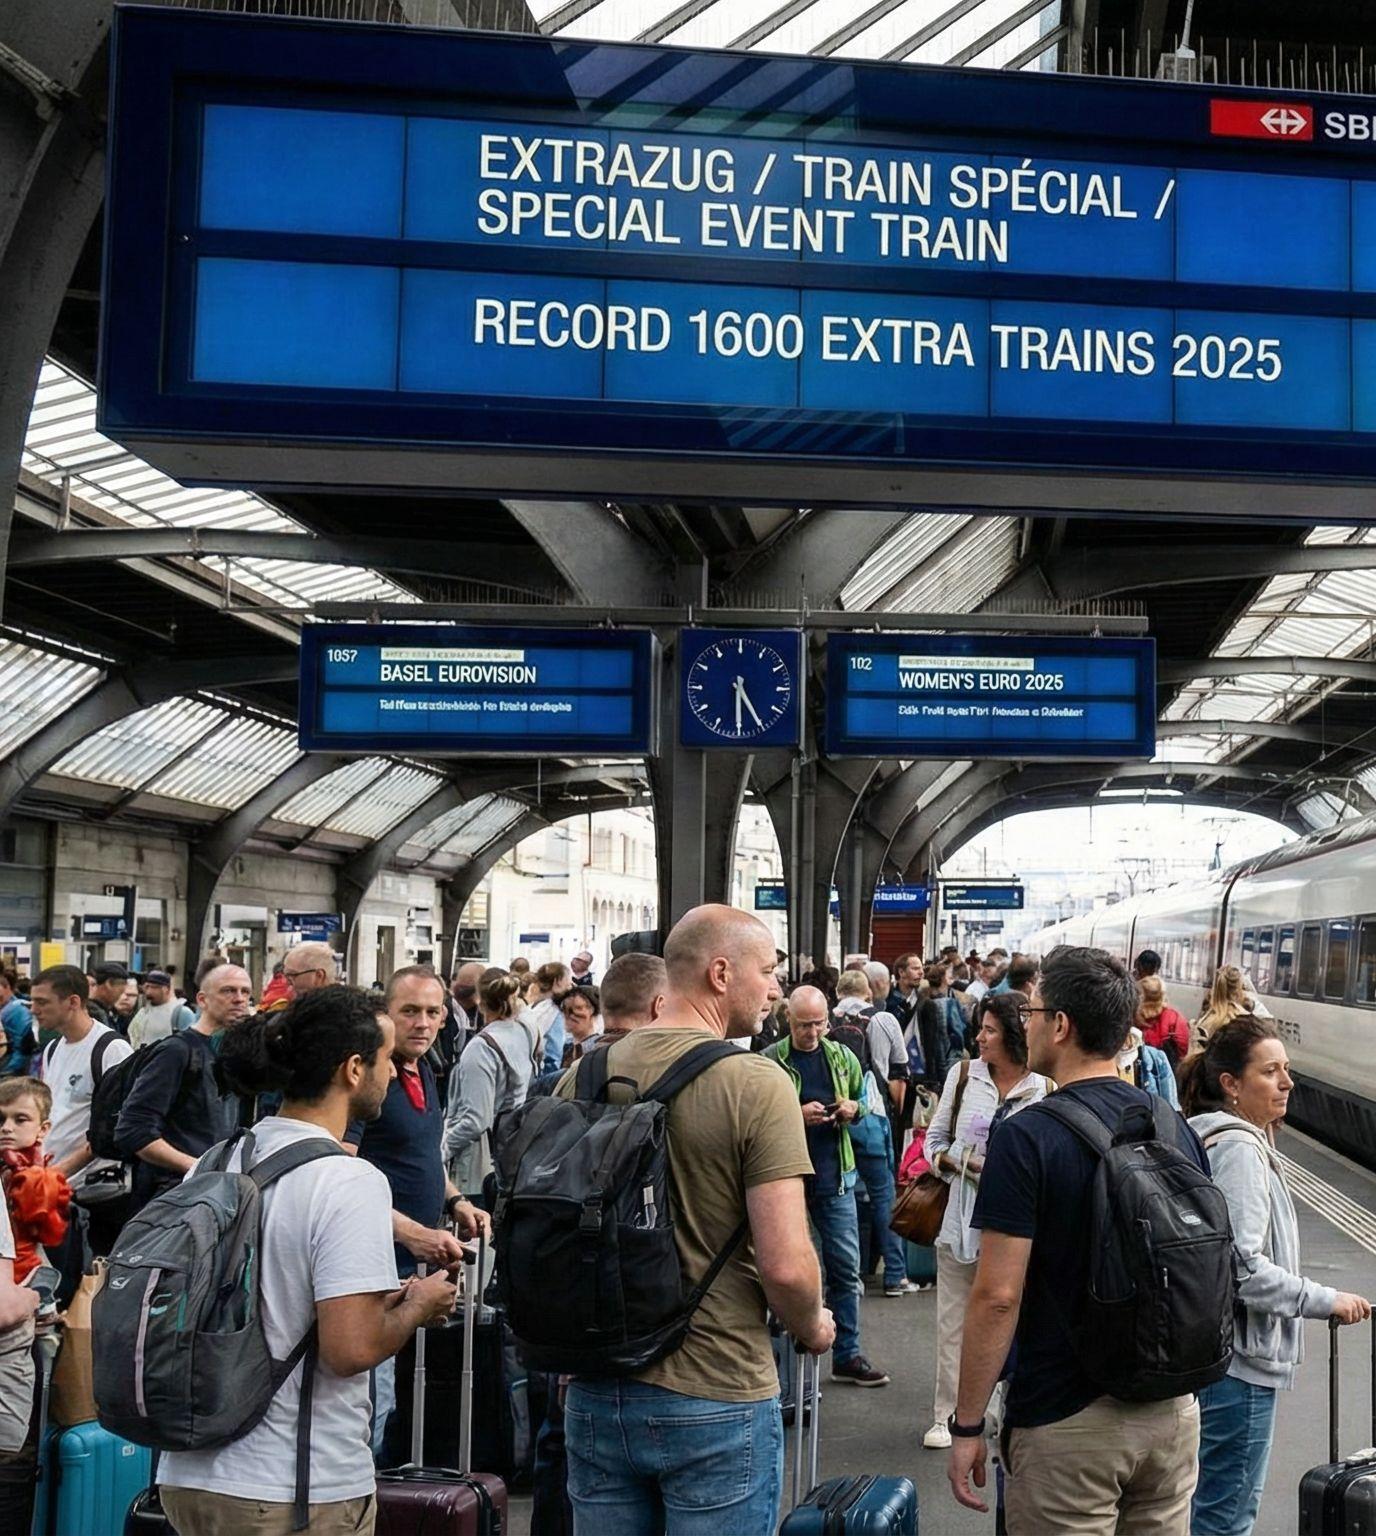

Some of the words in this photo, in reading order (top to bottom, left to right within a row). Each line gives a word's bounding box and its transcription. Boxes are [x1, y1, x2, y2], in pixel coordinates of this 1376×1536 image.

[480, 134, 735, 194] EXTRAZUG
[752, 153, 777, 196] /
[793, 154, 931, 206] TRAIN
[949, 159, 1138, 218] SPÉCIAL
[1154, 179, 1176, 220] /
[477, 188, 681, 244] SPECIAL
[701, 202, 855, 253] EVENT
[870, 212, 1008, 263] TRAIN
[474, 298, 671, 353] RECORD
[689, 309, 804, 359] 1600
[822, 316, 975, 367] EXTRA
[990, 324, 1155, 376] TRAINS
[1172, 334, 1282, 382] 2025
[380, 664, 433, 683] BASEL
[438, 665, 537, 684] EUROVISION
[850, 657, 872, 671] 102
[899, 671, 975, 690] WOMEN'S
[979, 673, 1021, 690] EURO
[1025, 674, 1064, 691] 2025
